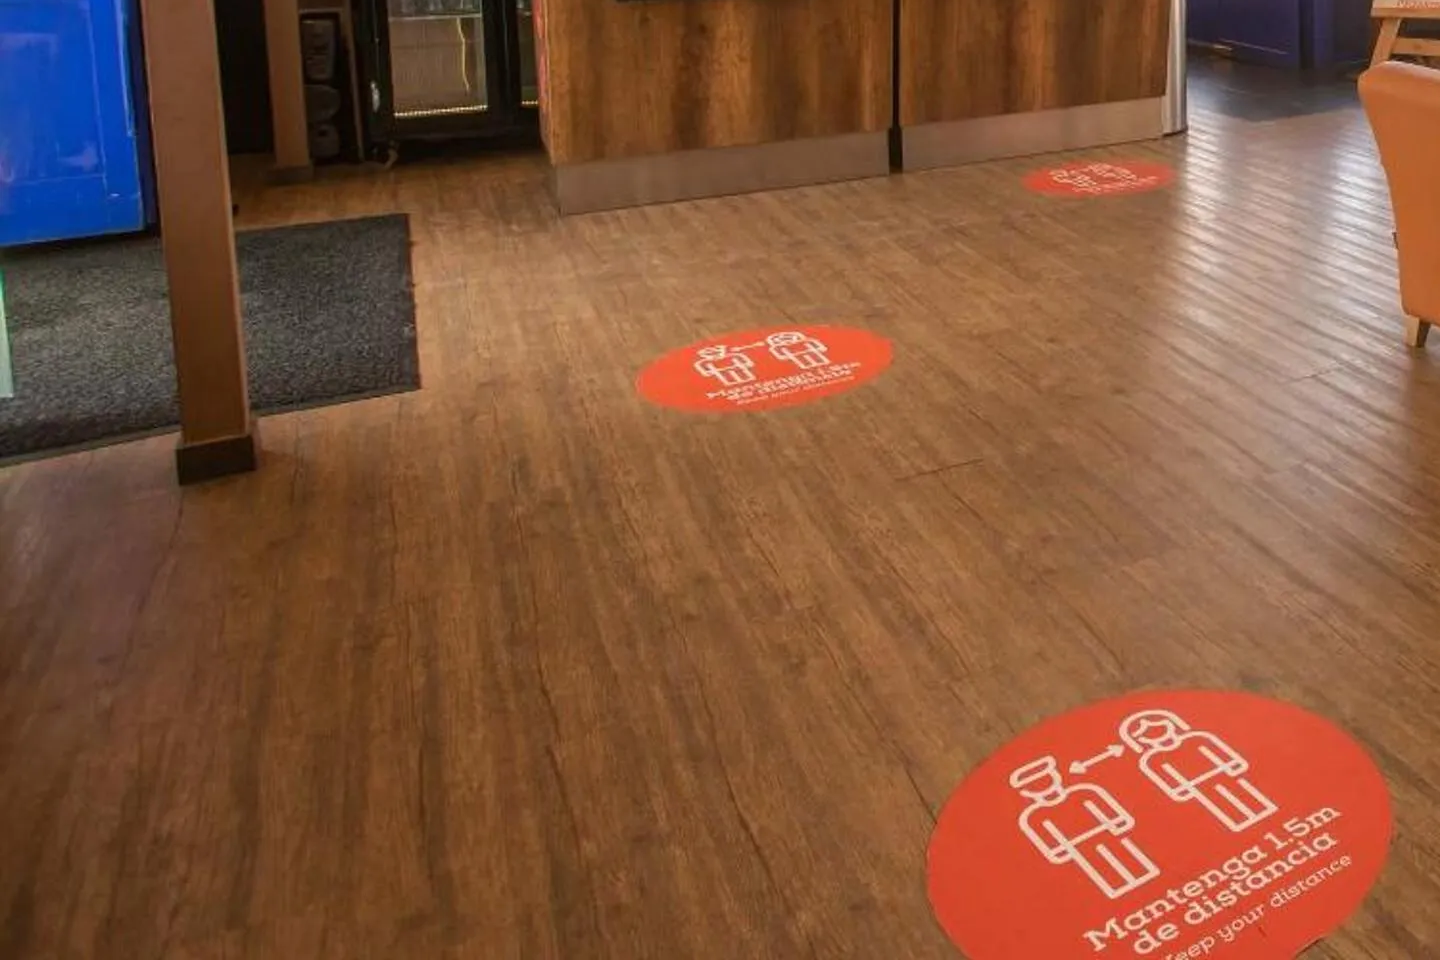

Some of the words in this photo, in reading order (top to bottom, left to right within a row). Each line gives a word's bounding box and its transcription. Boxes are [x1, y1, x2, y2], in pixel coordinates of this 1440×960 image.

[1083, 844, 1268, 951] Mantenga
[1263, 806, 1342, 851] 1.5m
[1133, 922, 1180, 955] de
[1183, 831, 1338, 926] distancia
[1217, 903, 1266, 943] your
[1269, 853, 1352, 908] distance
